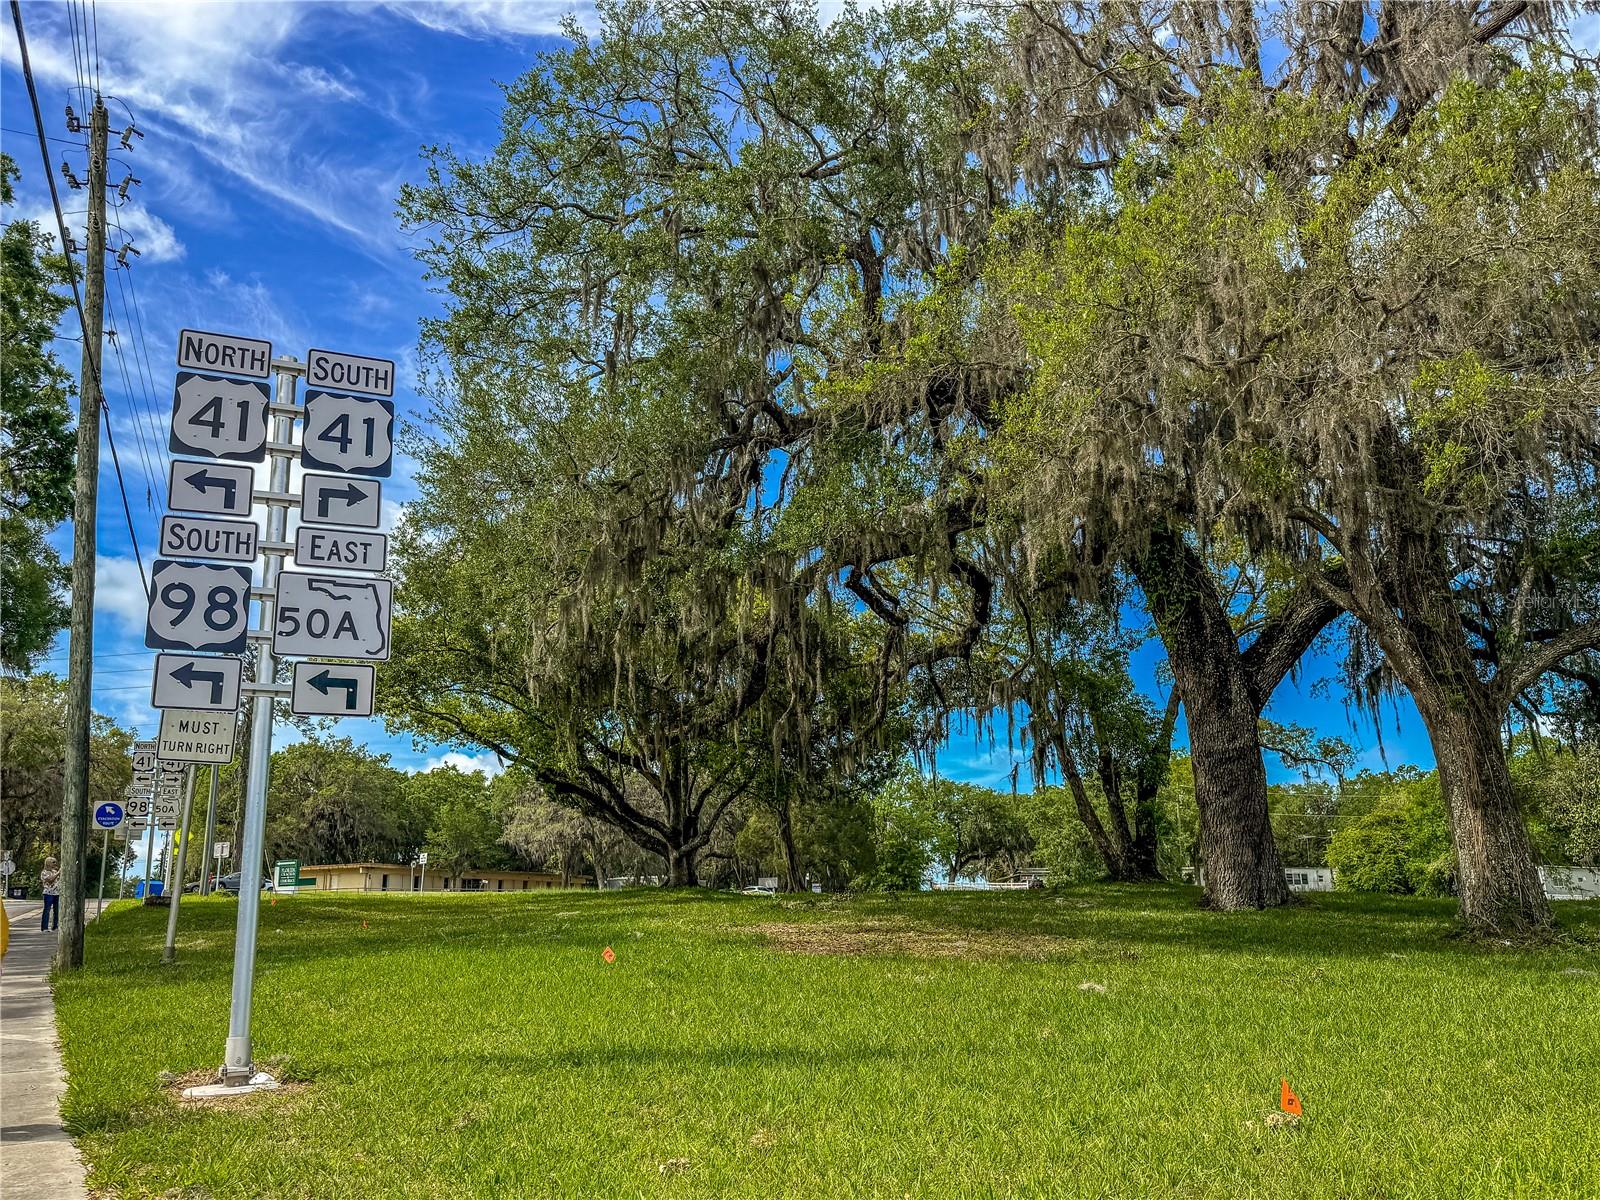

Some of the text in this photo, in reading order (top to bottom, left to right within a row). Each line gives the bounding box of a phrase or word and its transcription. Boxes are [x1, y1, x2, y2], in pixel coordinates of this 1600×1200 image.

[184, 336, 266, 372] NORTH
[313, 356, 389, 391] SOUTH
[188, 396, 251, 442] 41
[317, 413, 375, 457] 41
[167, 523, 251, 555] SOUTH
[310, 534, 373, 564] EAST
[160, 581, 238, 632] 98
[277, 606, 360, 641] 50A
[178, 719, 220, 735] MUST
[134, 743, 156, 751] NORTH
[136, 756, 152, 768] 41
[163, 740, 230, 754] TURN RIGHT
[131, 787, 151, 796] SOUTH
[129, 801, 148, 813] 98
[155, 805, 175, 814] 50A
